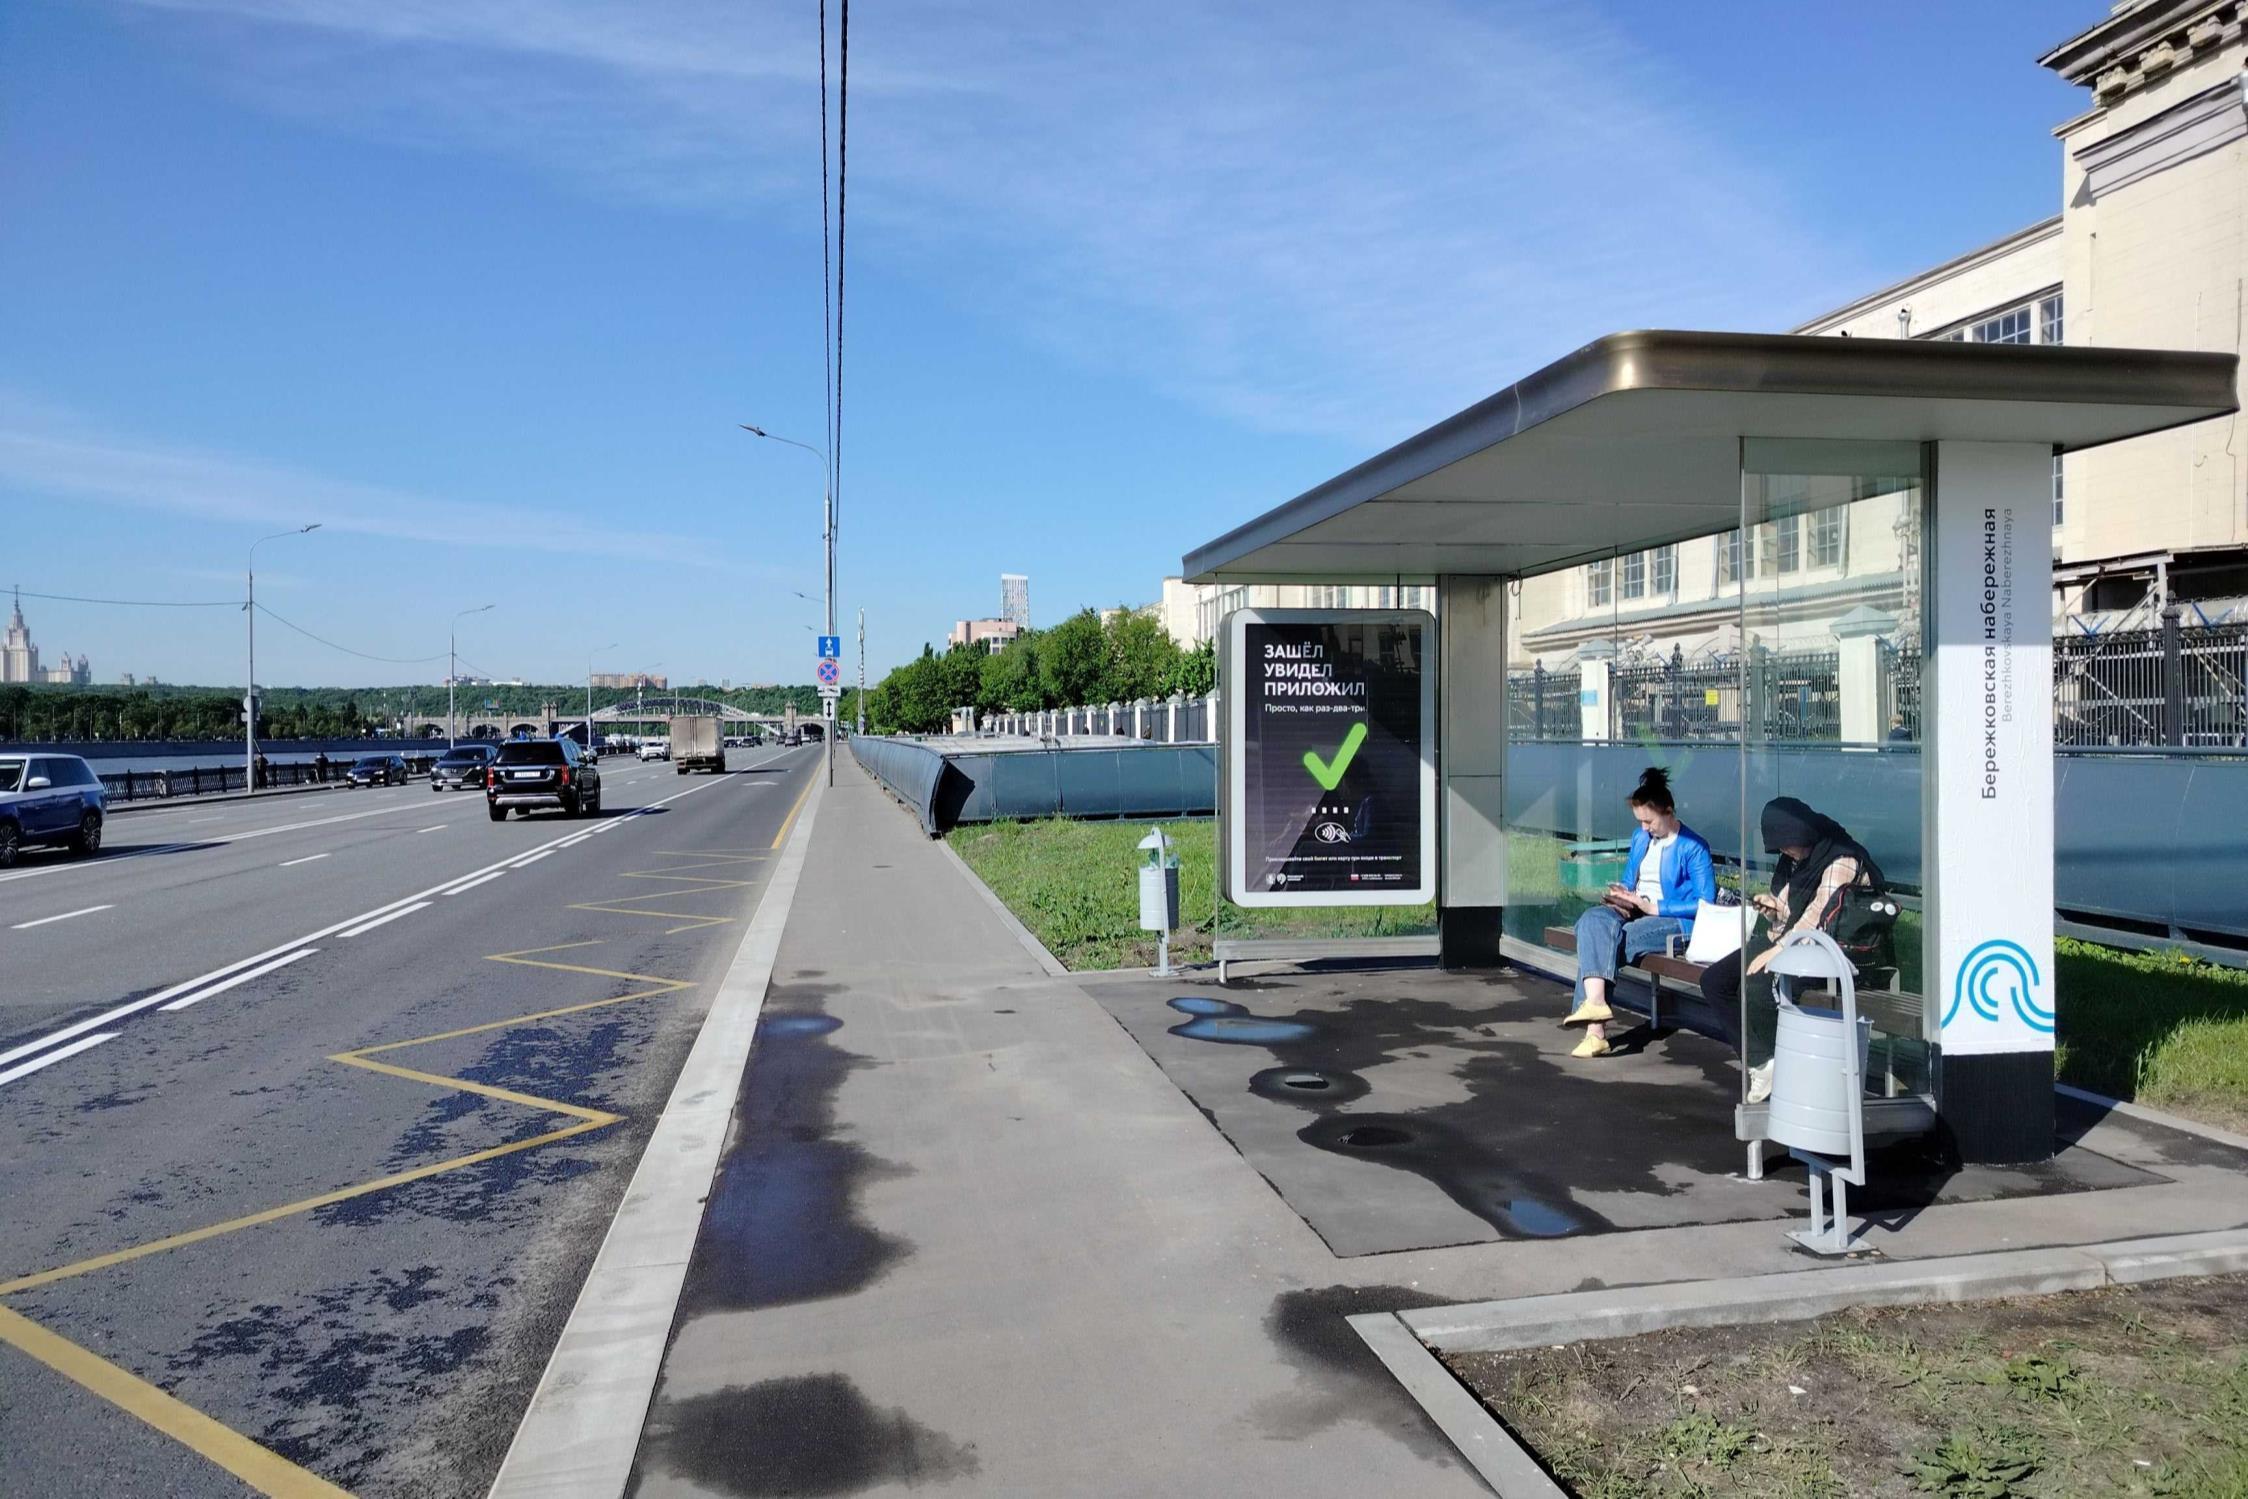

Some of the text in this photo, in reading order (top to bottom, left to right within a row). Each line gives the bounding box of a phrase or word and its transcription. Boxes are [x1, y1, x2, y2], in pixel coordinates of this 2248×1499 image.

[2002, 508, 2013, 723] Berezhkovskaya Naberezhnaya
[1264, 641, 1323, 659] ЗАШЁЛ
[1980, 508, 1999, 800] Бережковская набережная
[1264, 663, 1332, 679] УВИДЕЛ
[1264, 682, 1365, 696] ПРИЛОЖИЛ
[1264, 703, 1298, 713] Просто,
